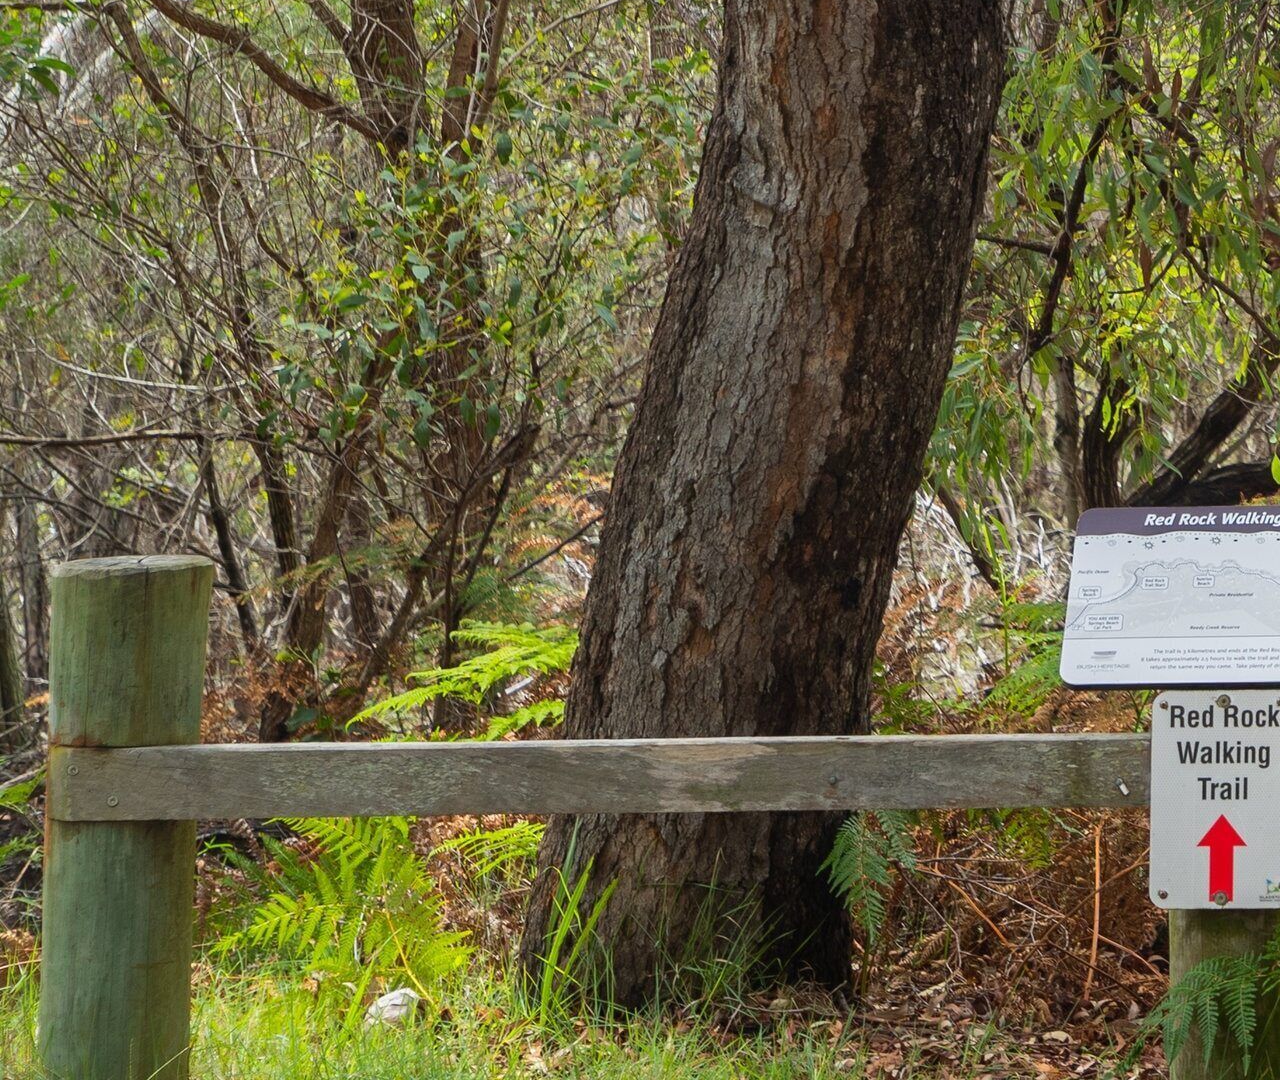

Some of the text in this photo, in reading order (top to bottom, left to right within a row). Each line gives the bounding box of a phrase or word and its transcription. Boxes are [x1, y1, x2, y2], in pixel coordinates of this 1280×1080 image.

[1144, 513, 1175, 526] Red
[1178, 513, 1218, 525] Rock
[1170, 705, 1280, 728] Red Rock
[1176, 741, 1271, 769] Walking
[1197, 777, 1248, 800] Trail
